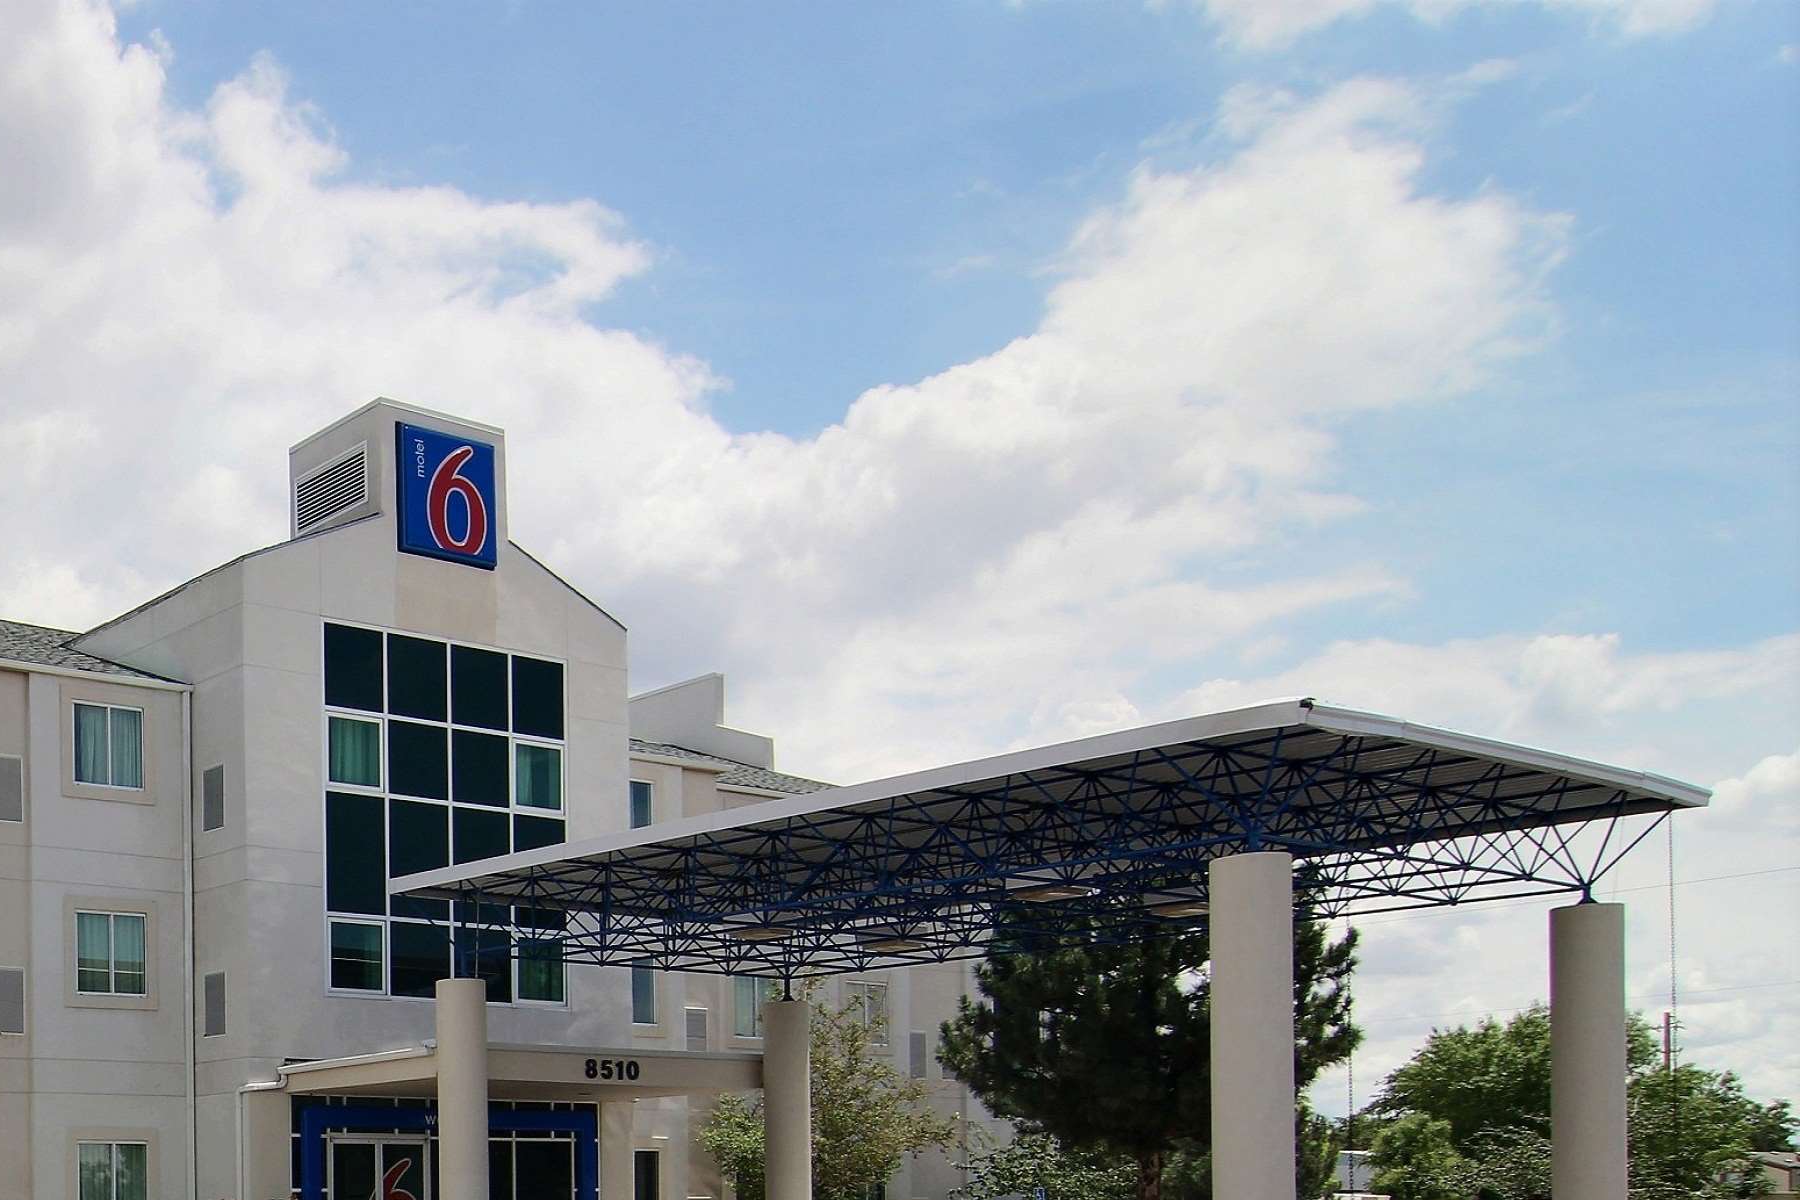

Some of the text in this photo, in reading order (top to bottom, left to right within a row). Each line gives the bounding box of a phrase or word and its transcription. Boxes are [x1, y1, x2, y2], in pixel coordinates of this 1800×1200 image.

[414, 439, 425, 478] motel
[427, 445, 488, 556] 6
[584, 1058, 640, 1081] 8510
